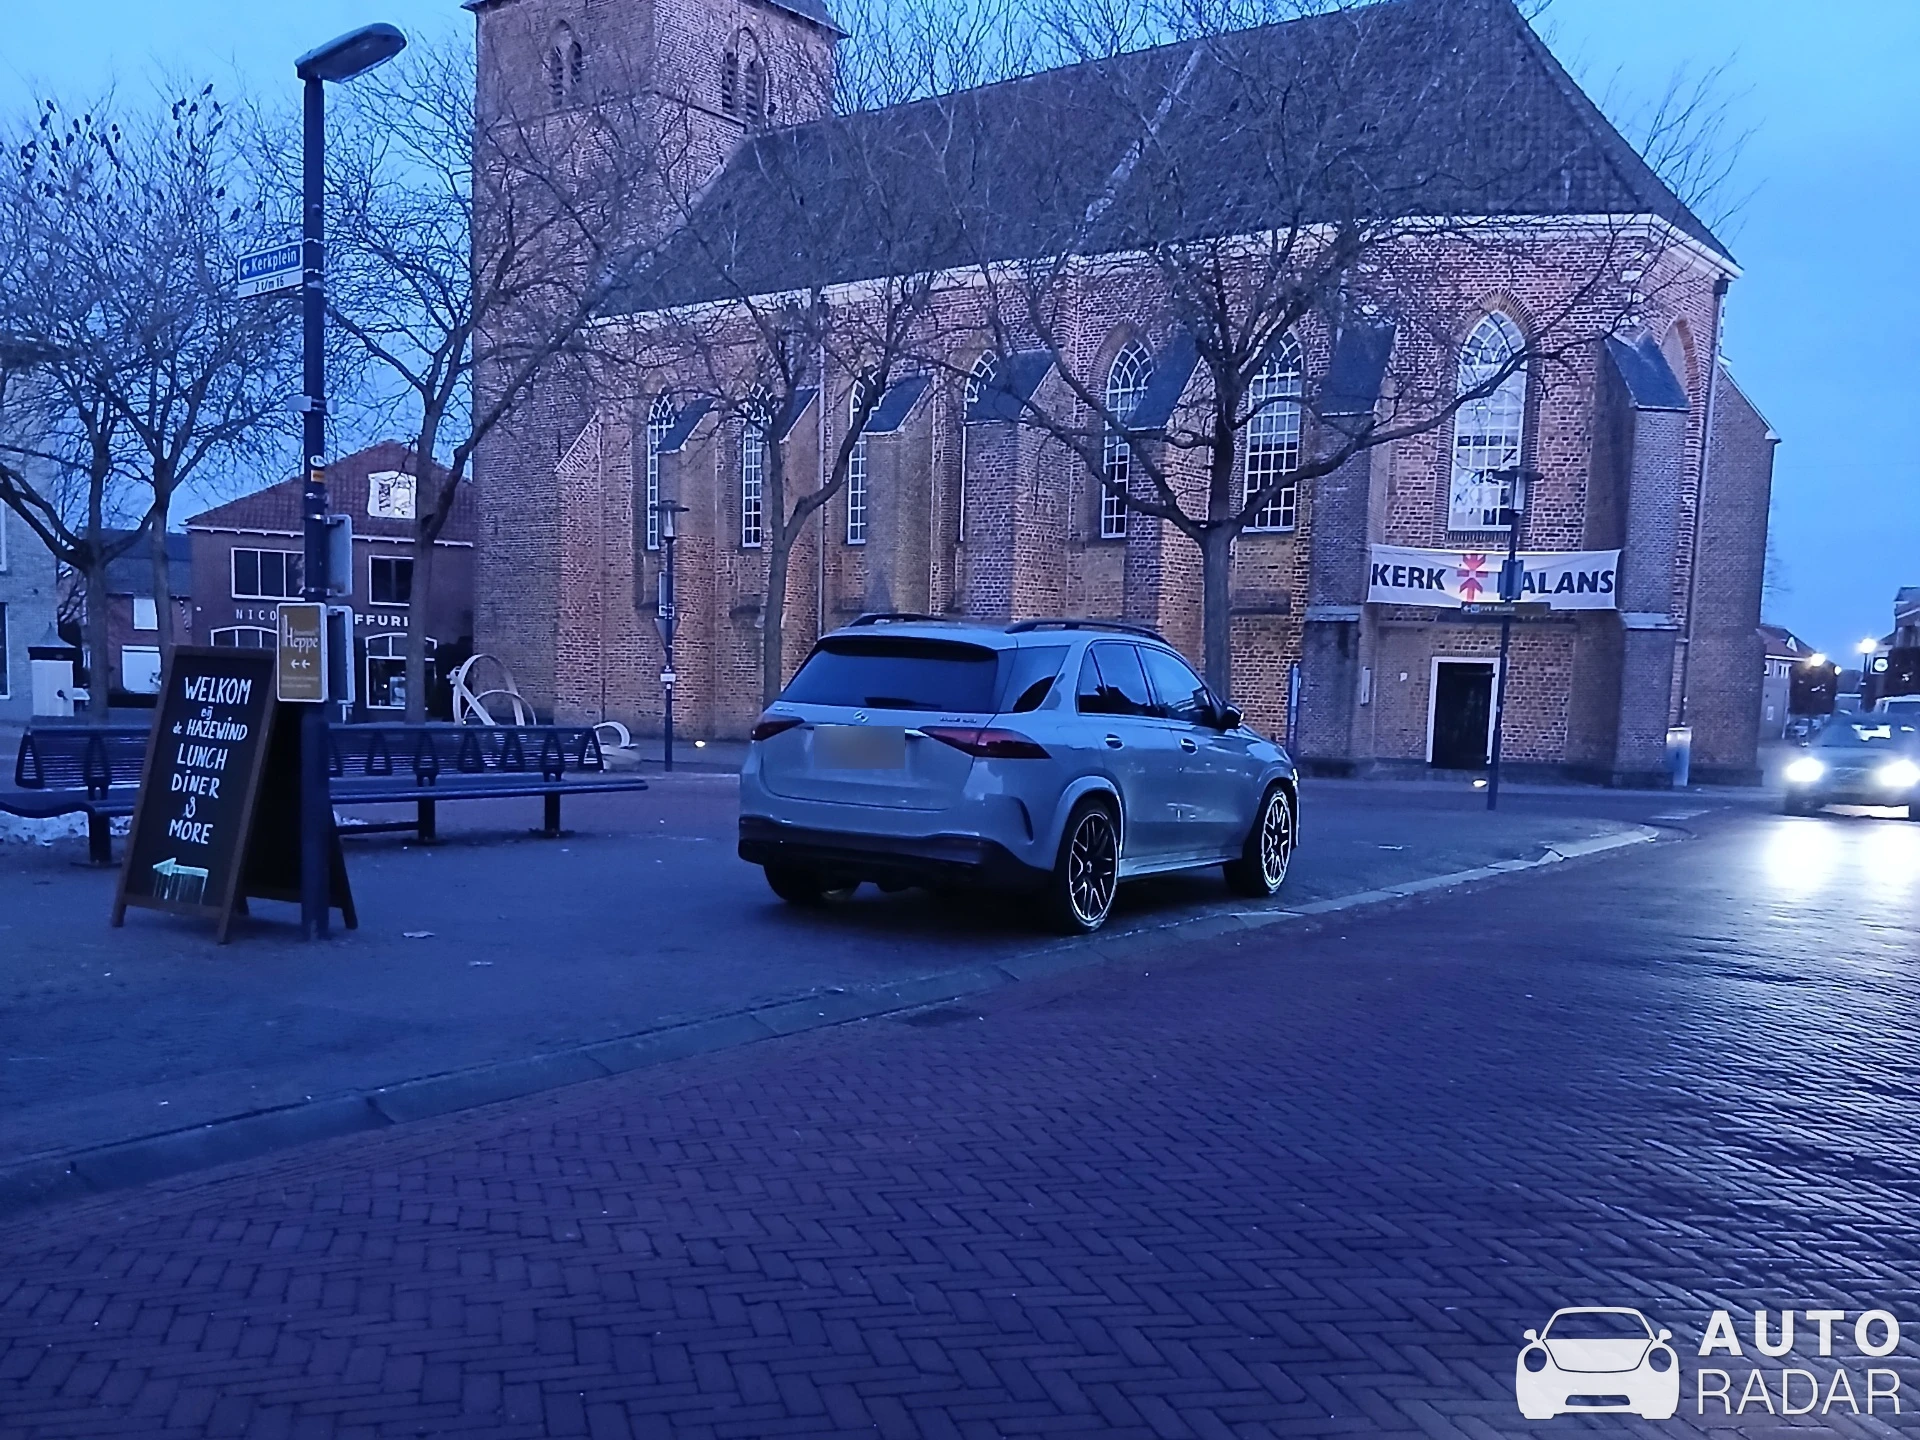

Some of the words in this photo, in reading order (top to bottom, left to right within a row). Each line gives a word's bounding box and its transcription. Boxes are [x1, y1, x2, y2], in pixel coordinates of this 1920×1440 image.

[251, 247, 297, 272] Kerkplein
[255, 281, 260, 293] 2
[1371, 563, 1447, 590] KERK
[1497, 570, 1615, 593] ALANS
[236, 609, 276, 621] NICO
[281, 614, 319, 654] Heppe
[185, 676, 252, 705] WELKOM
[177, 743, 228, 771] LUNCH
[171, 770, 220, 799] DINER
[168, 819, 214, 845] MORE
